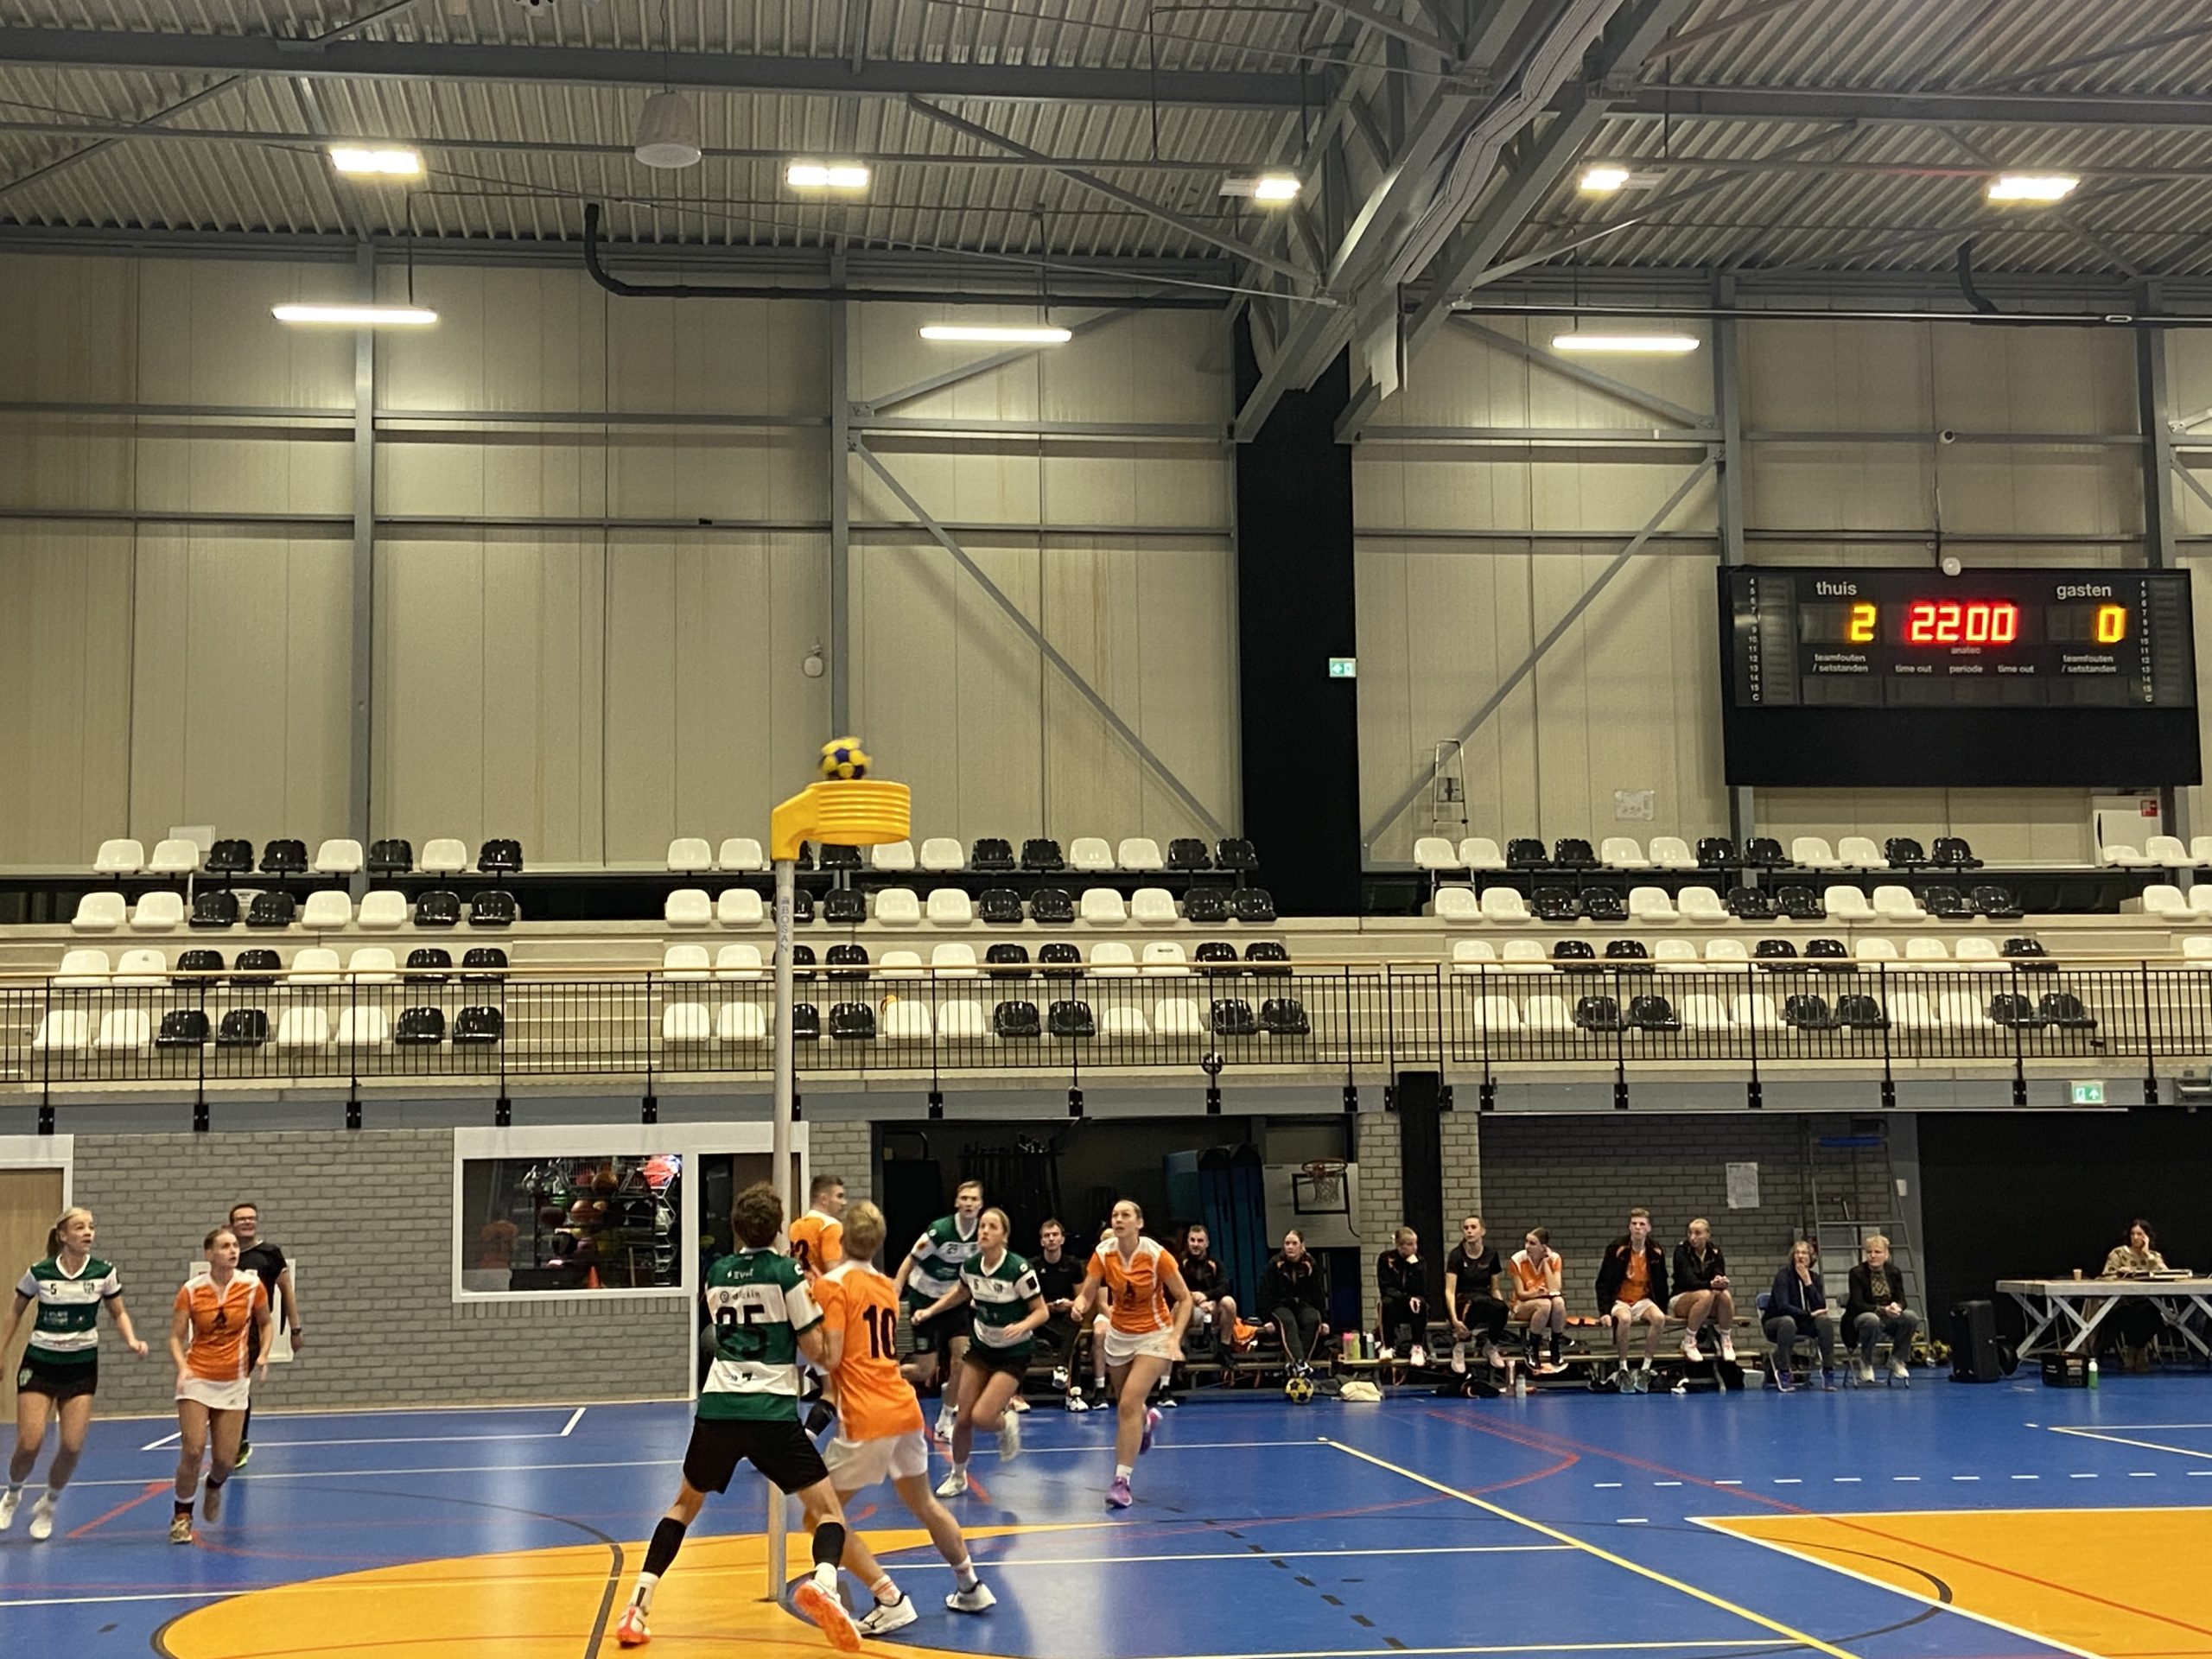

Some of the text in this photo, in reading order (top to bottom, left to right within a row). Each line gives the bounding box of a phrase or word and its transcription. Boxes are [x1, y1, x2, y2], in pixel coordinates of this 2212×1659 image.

[1815, 581, 1857, 595] thuis
[2056, 583, 2112, 600] gasten
[1851, 604, 1877, 641] 2
[2098, 606, 2126, 643] 0
[1815, 653, 1866, 662] teamfouten
[1819, 664, 1868, 672] setstanden
[1895, 664, 1932, 673] time out
[1948, 664, 1983, 674] periode
[1998, 664, 2035, 673] time out
[2068, 664, 2117, 673] setstanden
[781, 906, 790, 953] BOSAN
[862, 1305, 897, 1361] 10
